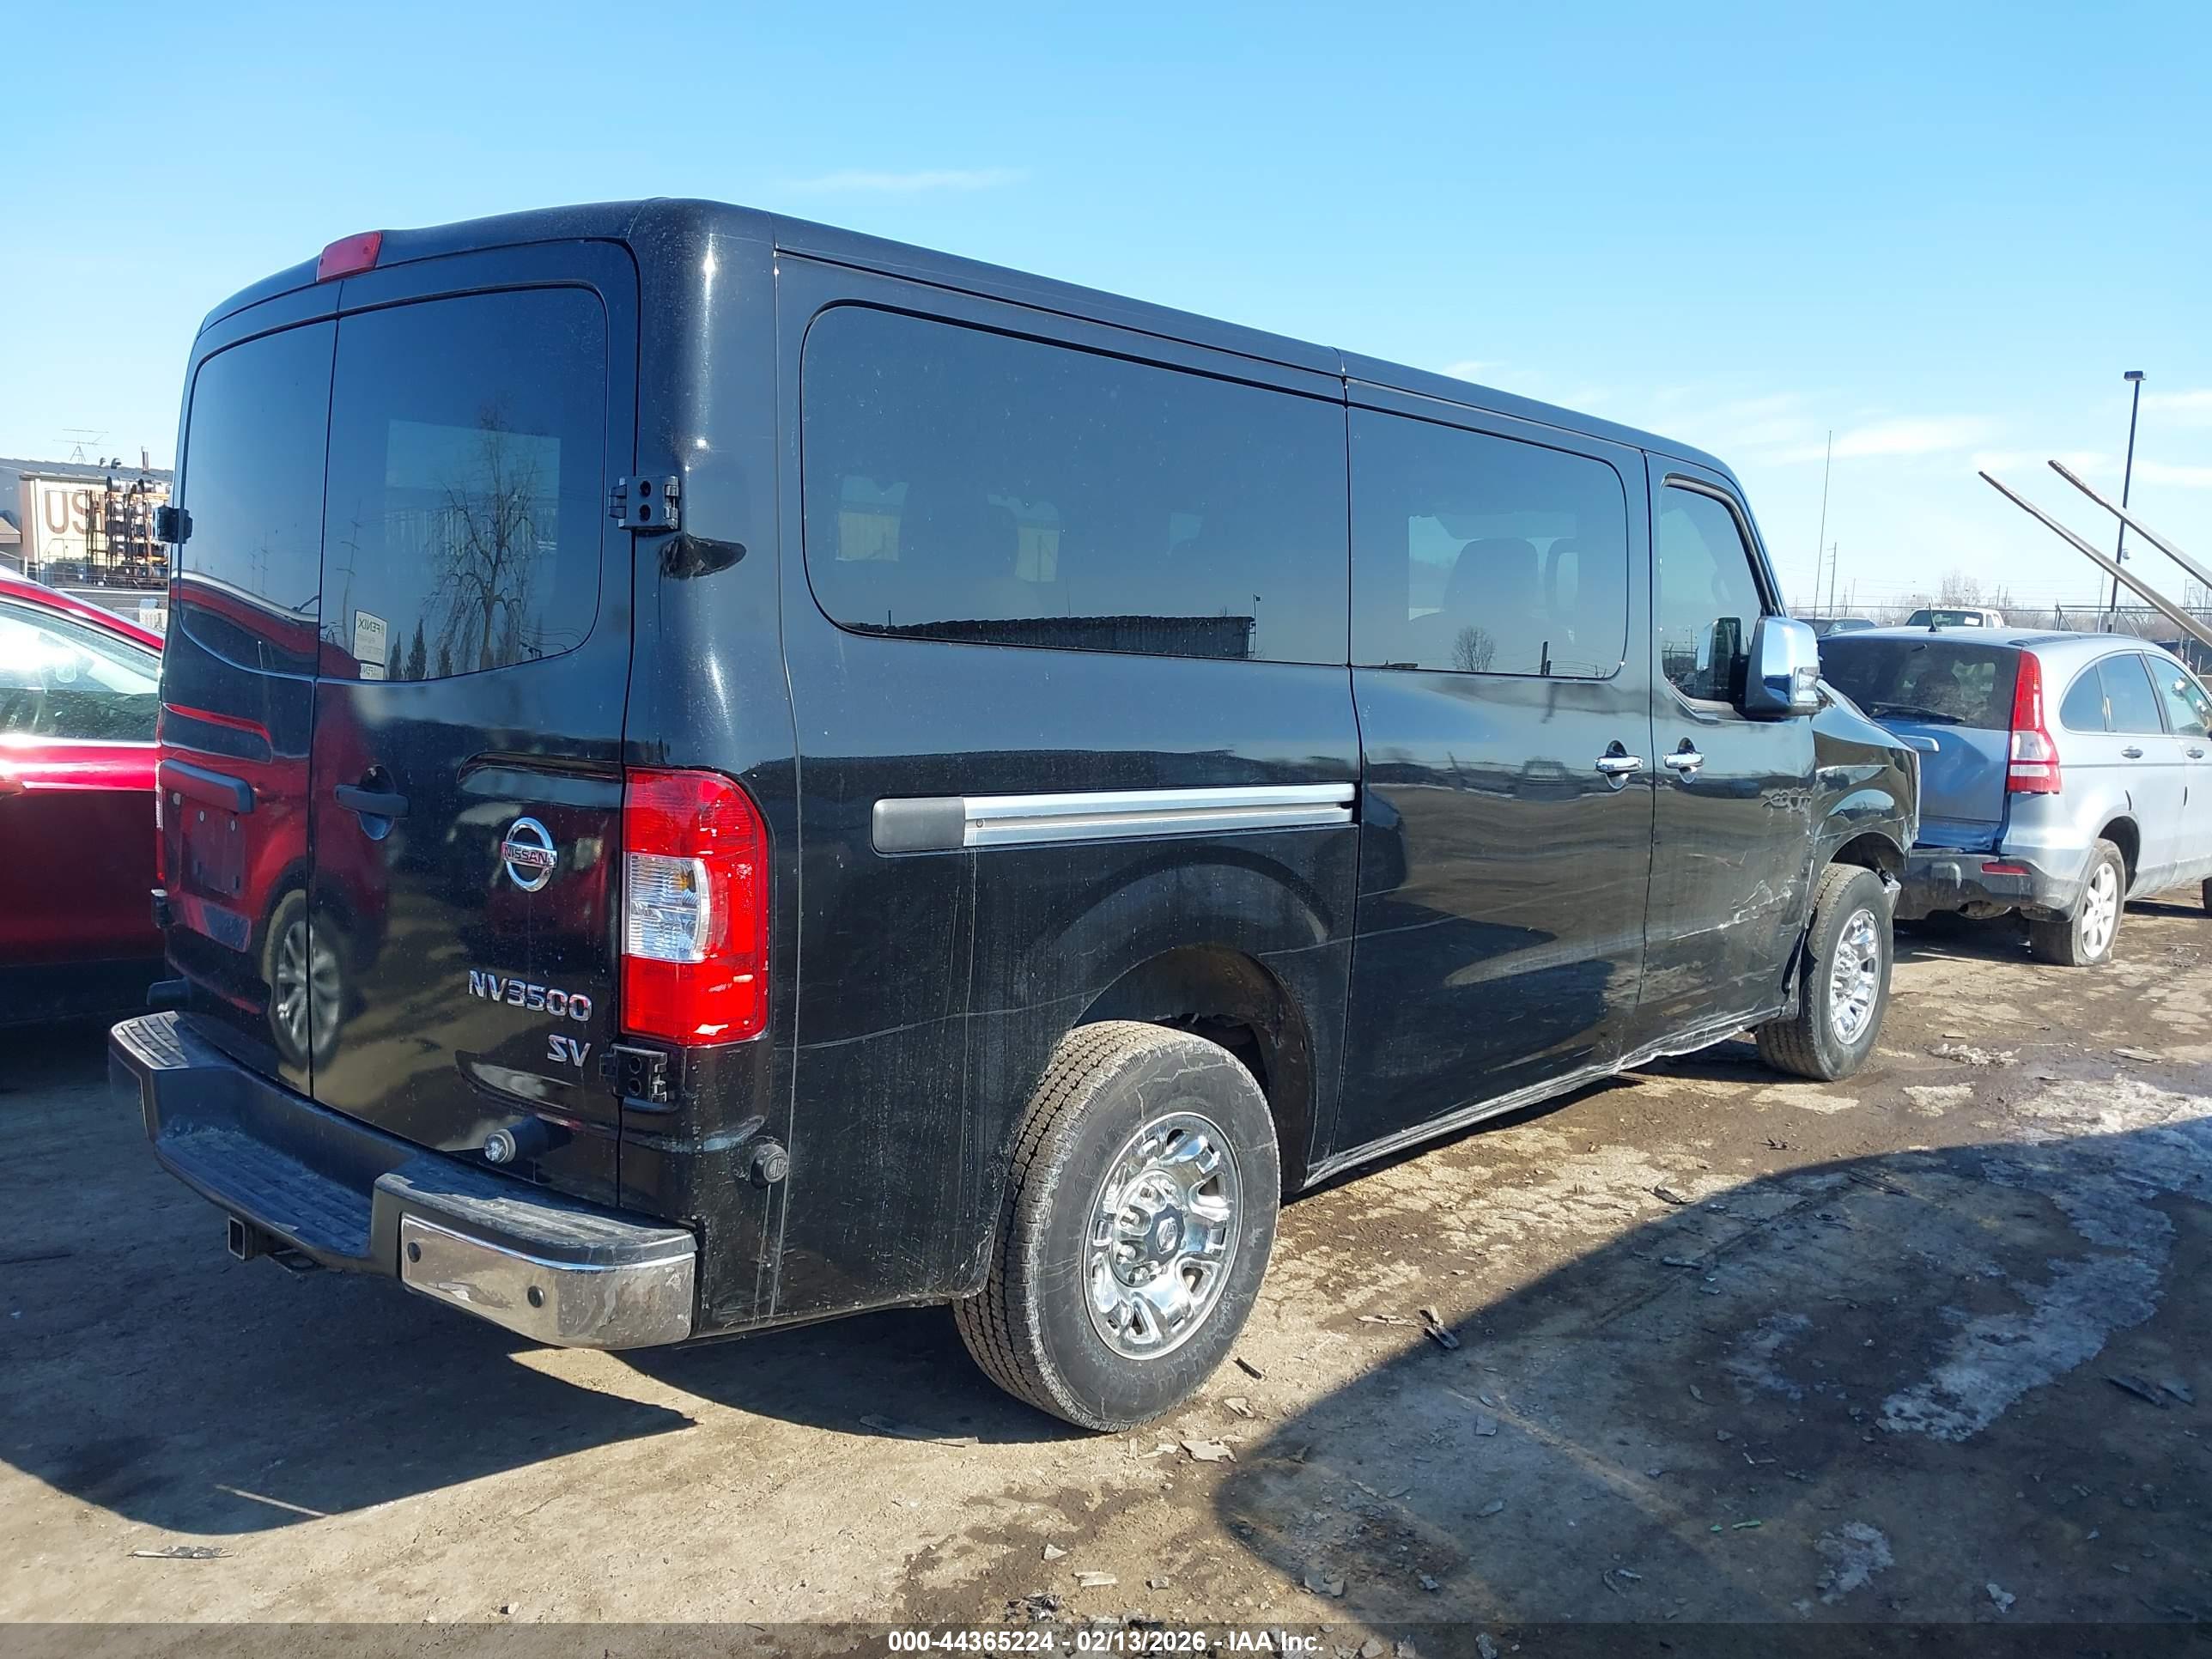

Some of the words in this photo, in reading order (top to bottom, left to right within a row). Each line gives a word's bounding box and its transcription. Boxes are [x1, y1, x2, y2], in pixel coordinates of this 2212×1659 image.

[503, 845, 549, 864] NISSAN
[468, 969, 592, 1022] NV3500
[547, 1034, 592, 1067] SV
